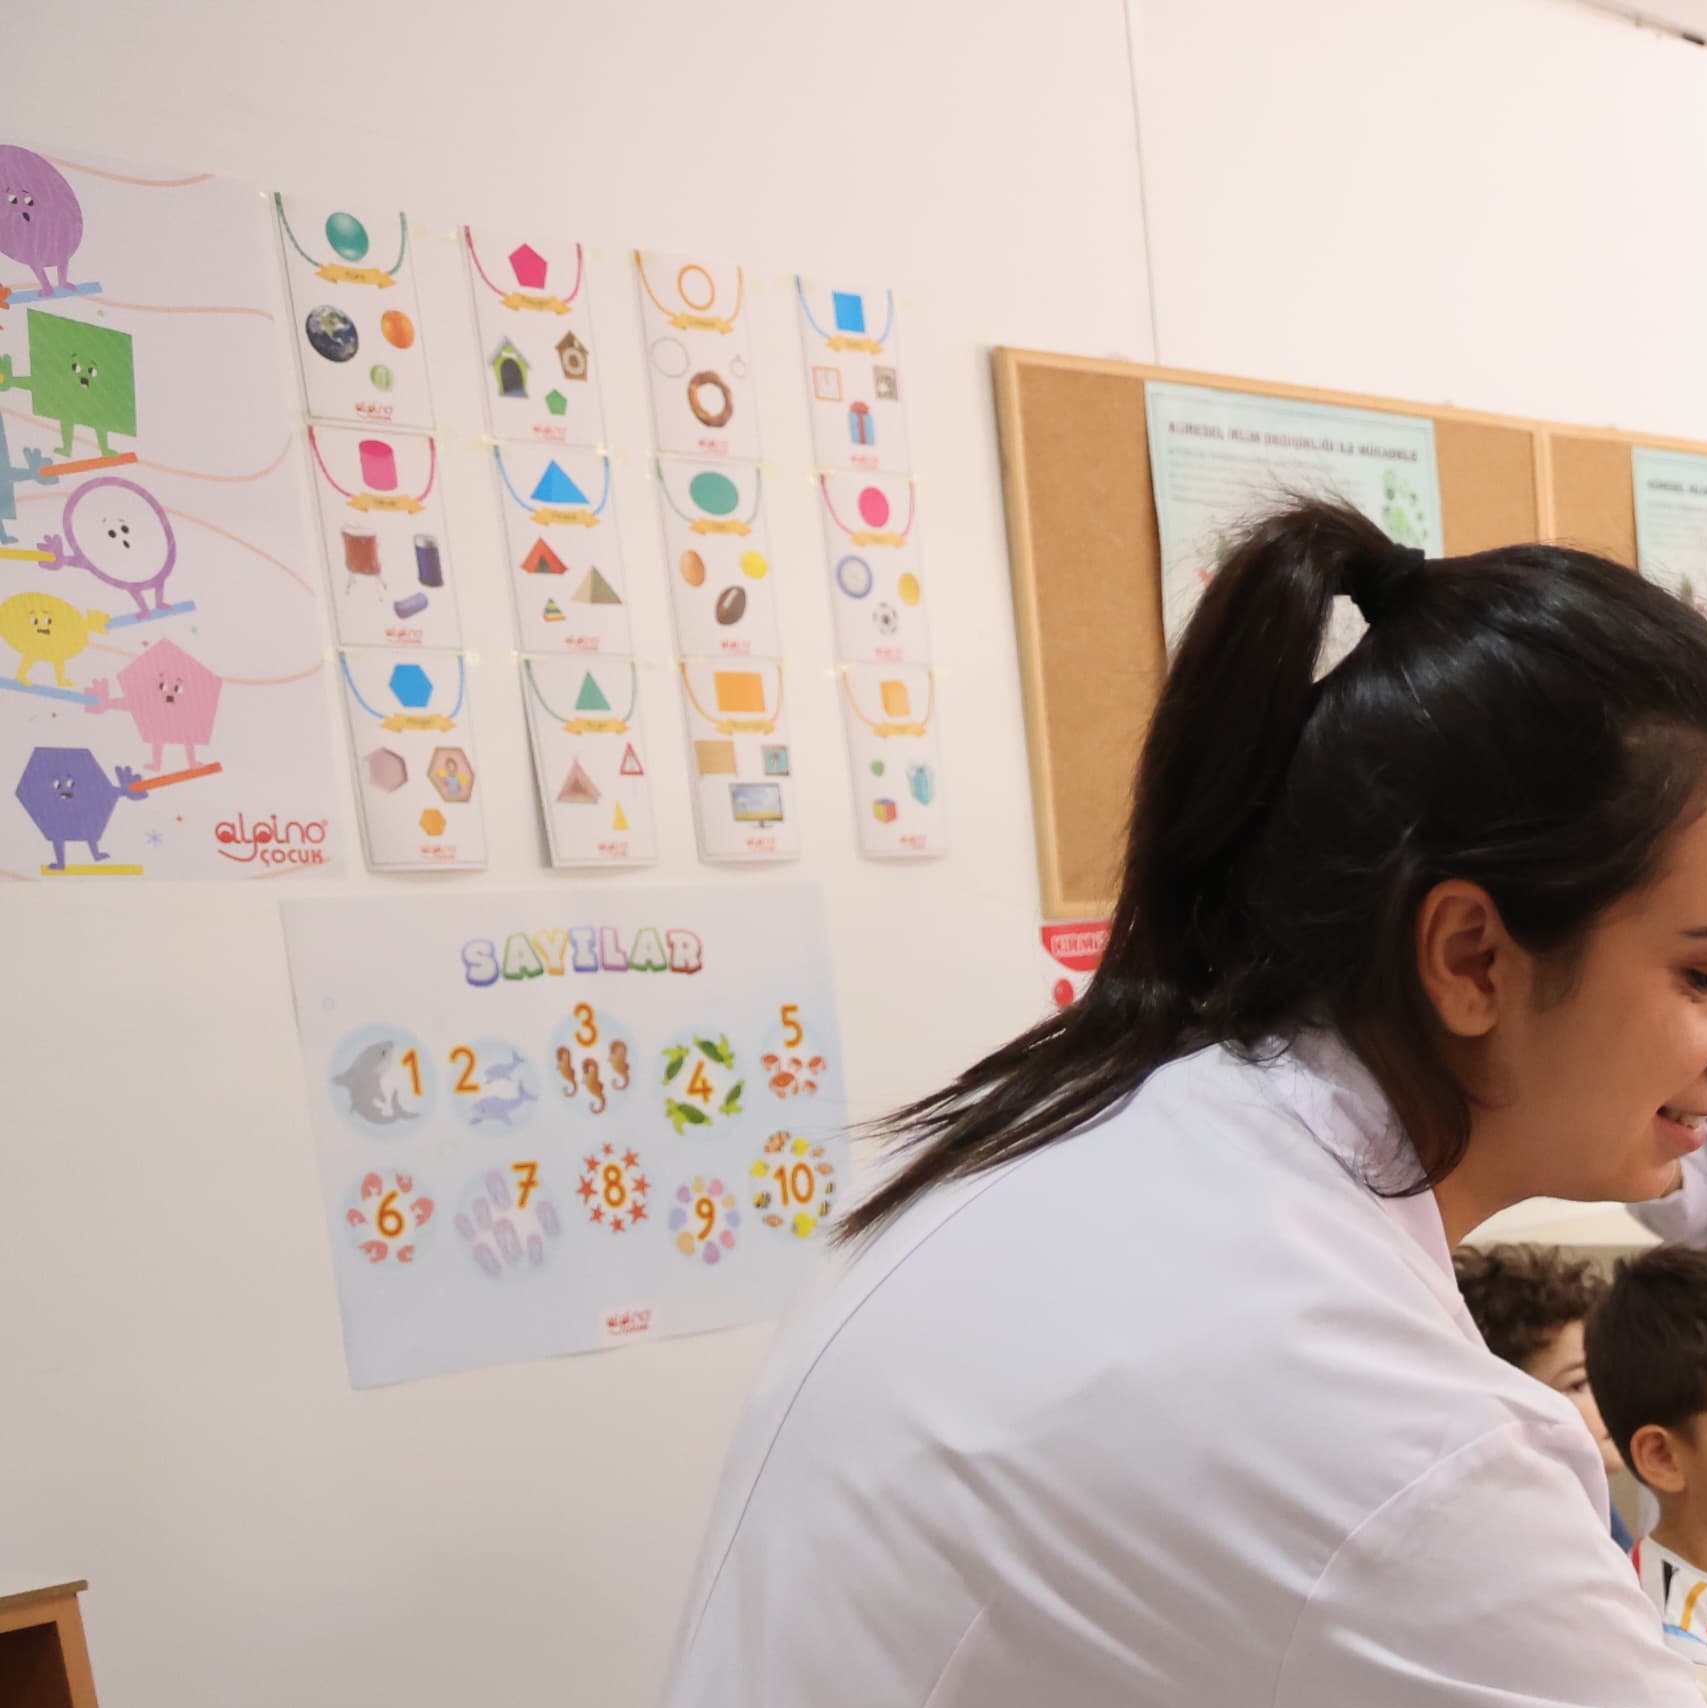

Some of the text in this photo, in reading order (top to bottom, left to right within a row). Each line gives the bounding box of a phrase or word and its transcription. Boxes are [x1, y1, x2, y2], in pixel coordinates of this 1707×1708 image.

[462, 926, 702, 987] SAYILAR
[402, 1002, 803, 1103] 1 2 3 4 5
[376, 1161, 815, 1242] 6 7 8 9 10
